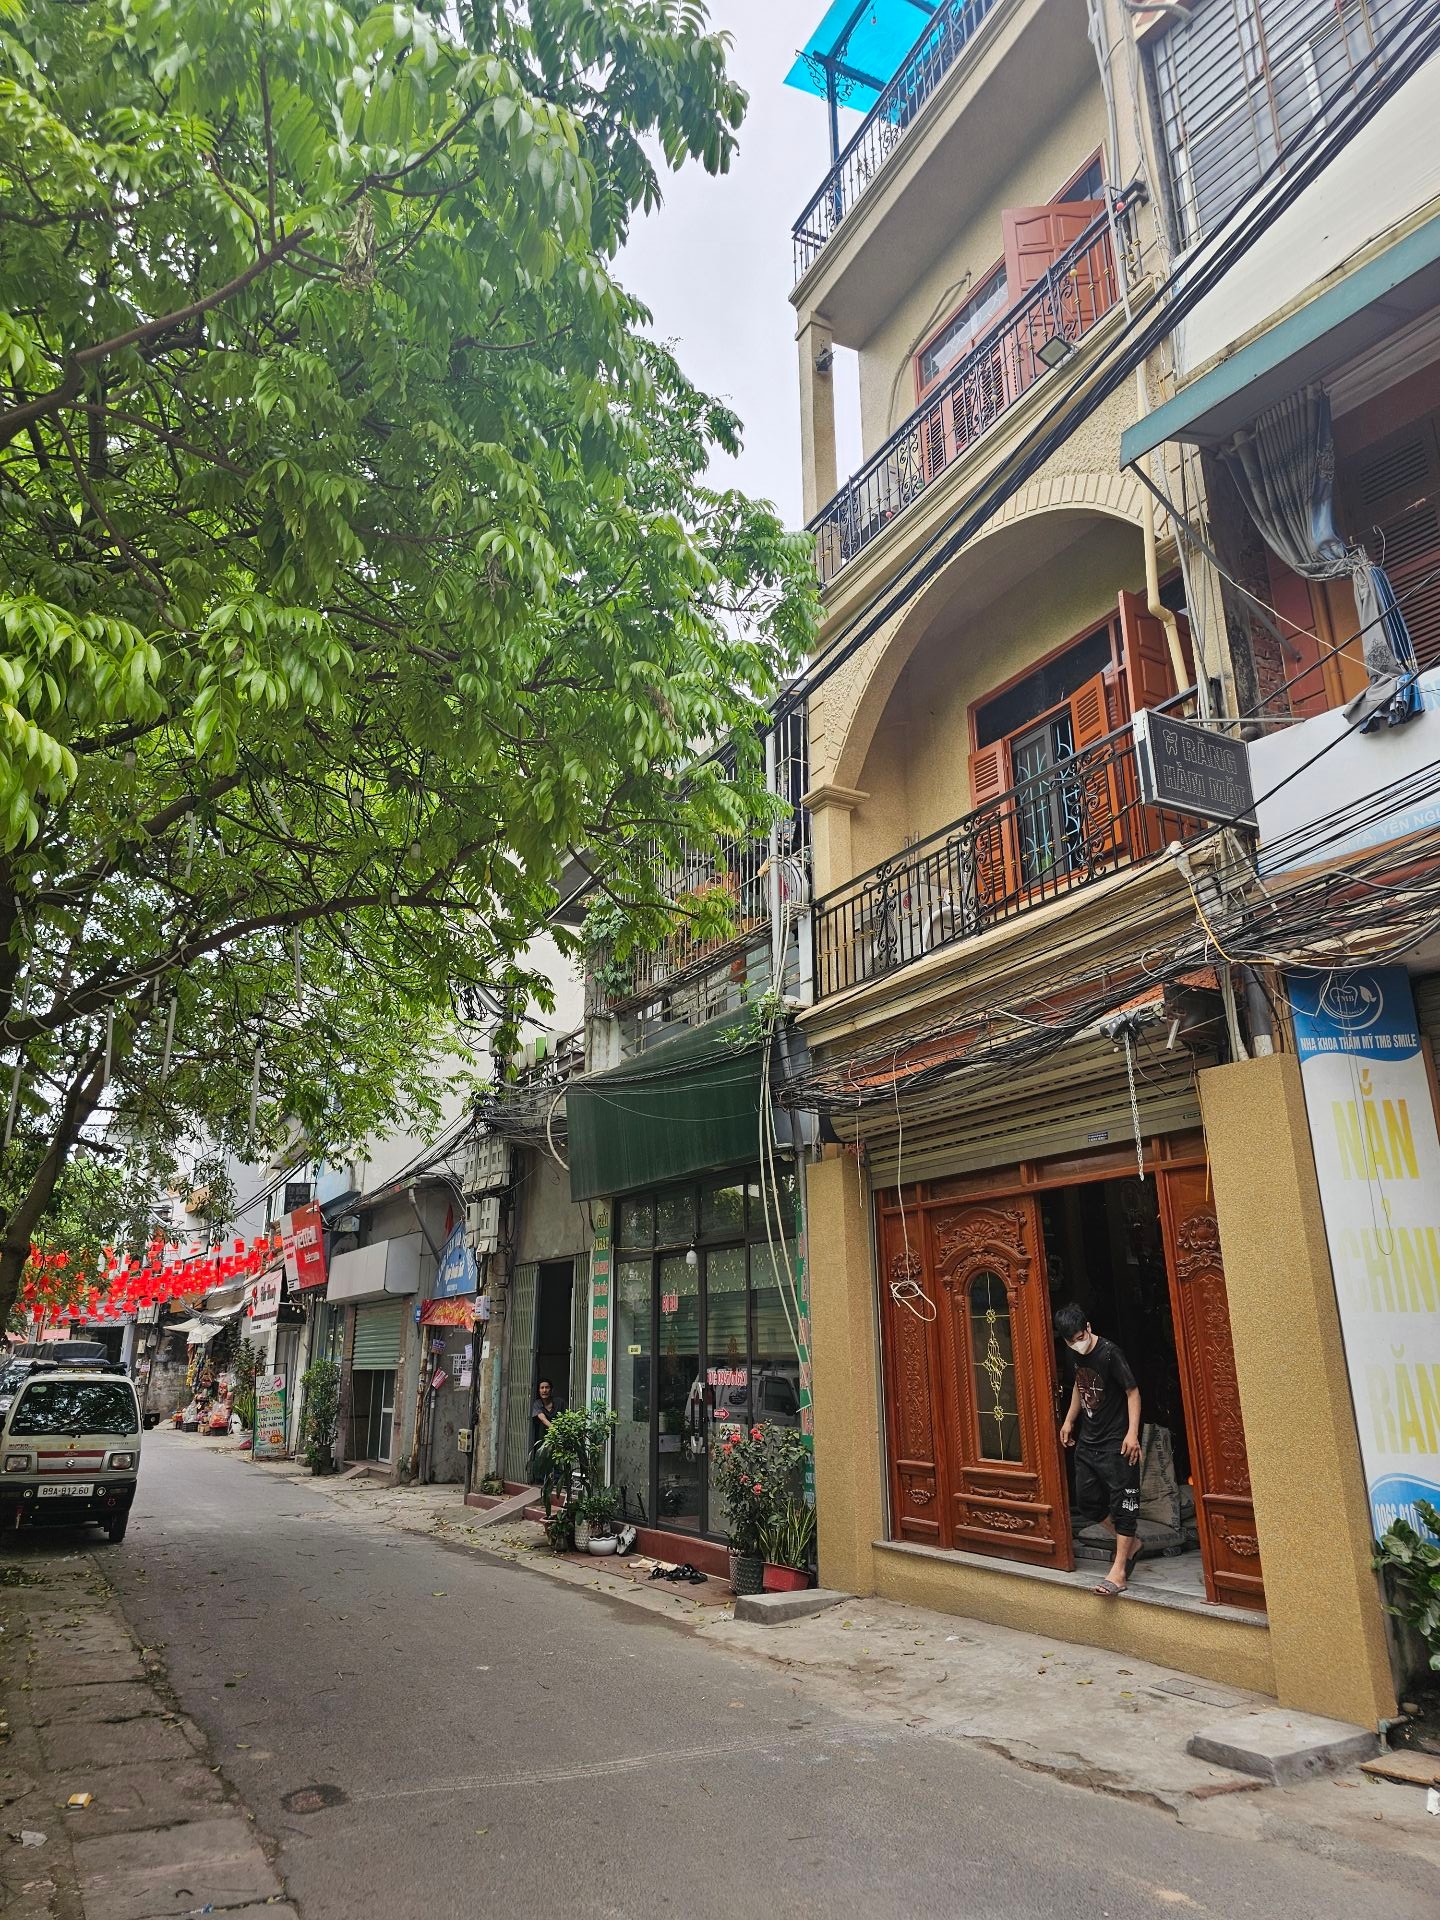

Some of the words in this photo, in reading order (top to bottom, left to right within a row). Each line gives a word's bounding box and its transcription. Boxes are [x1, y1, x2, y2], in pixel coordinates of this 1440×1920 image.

[1318, 1037, 1338, 1051] KHOA
[1375, 1035, 1392, 1049] TMB
[1394, 1033, 1418, 1048] SMILE
[1331, 1068, 1420, 1180] NẮN
